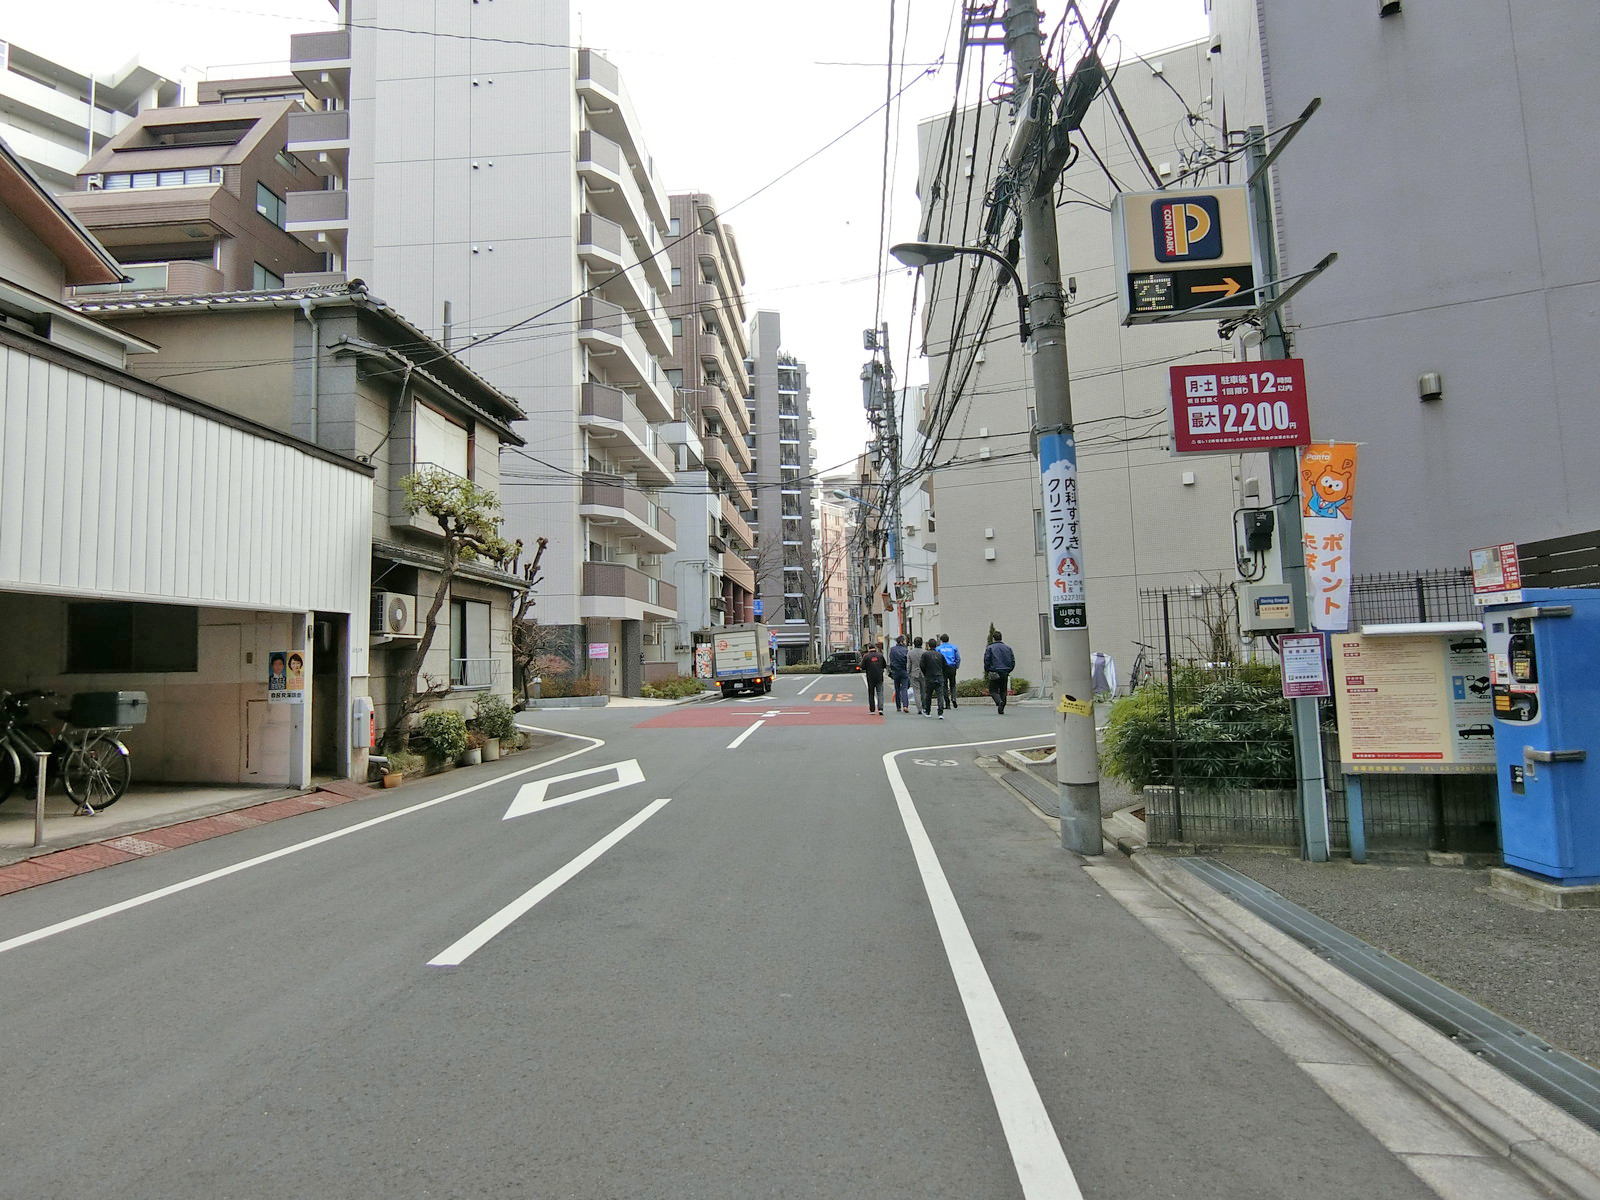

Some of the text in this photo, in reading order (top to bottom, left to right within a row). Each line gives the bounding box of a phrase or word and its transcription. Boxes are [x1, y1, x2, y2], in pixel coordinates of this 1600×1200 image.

[1164, 209, 1174, 253] COIN PARK
[1220, 375, 1248, 384] 駐車後
[1222, 387, 1249, 396] 1回限り
[1250, 372, 1276, 394] 12
[1192, 412, 1217, 428] 最大
[1048, 478, 1064, 550] クリニック
[1065, 477, 1079, 550] 内科すずき
[1322, 533, 1344, 615] ポイント
